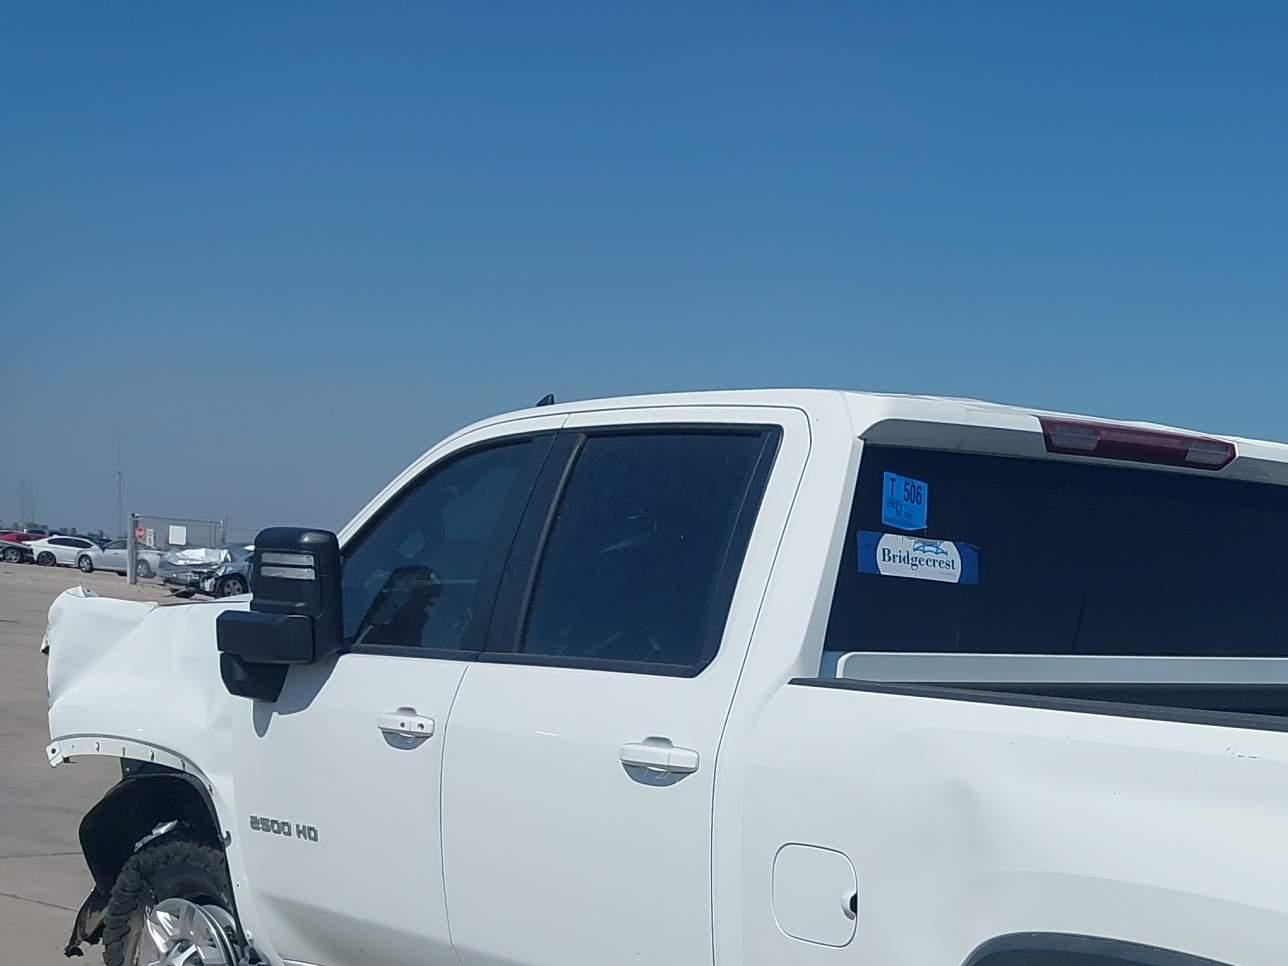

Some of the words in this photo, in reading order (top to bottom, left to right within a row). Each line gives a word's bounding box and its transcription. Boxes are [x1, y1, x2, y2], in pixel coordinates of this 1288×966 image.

[889, 478, 896, 497] T
[903, 480, 922, 506] 506
[882, 548, 956, 571] Bridgecrest
[249, 815, 292, 837] 2500
[295, 824, 319, 843] HD
